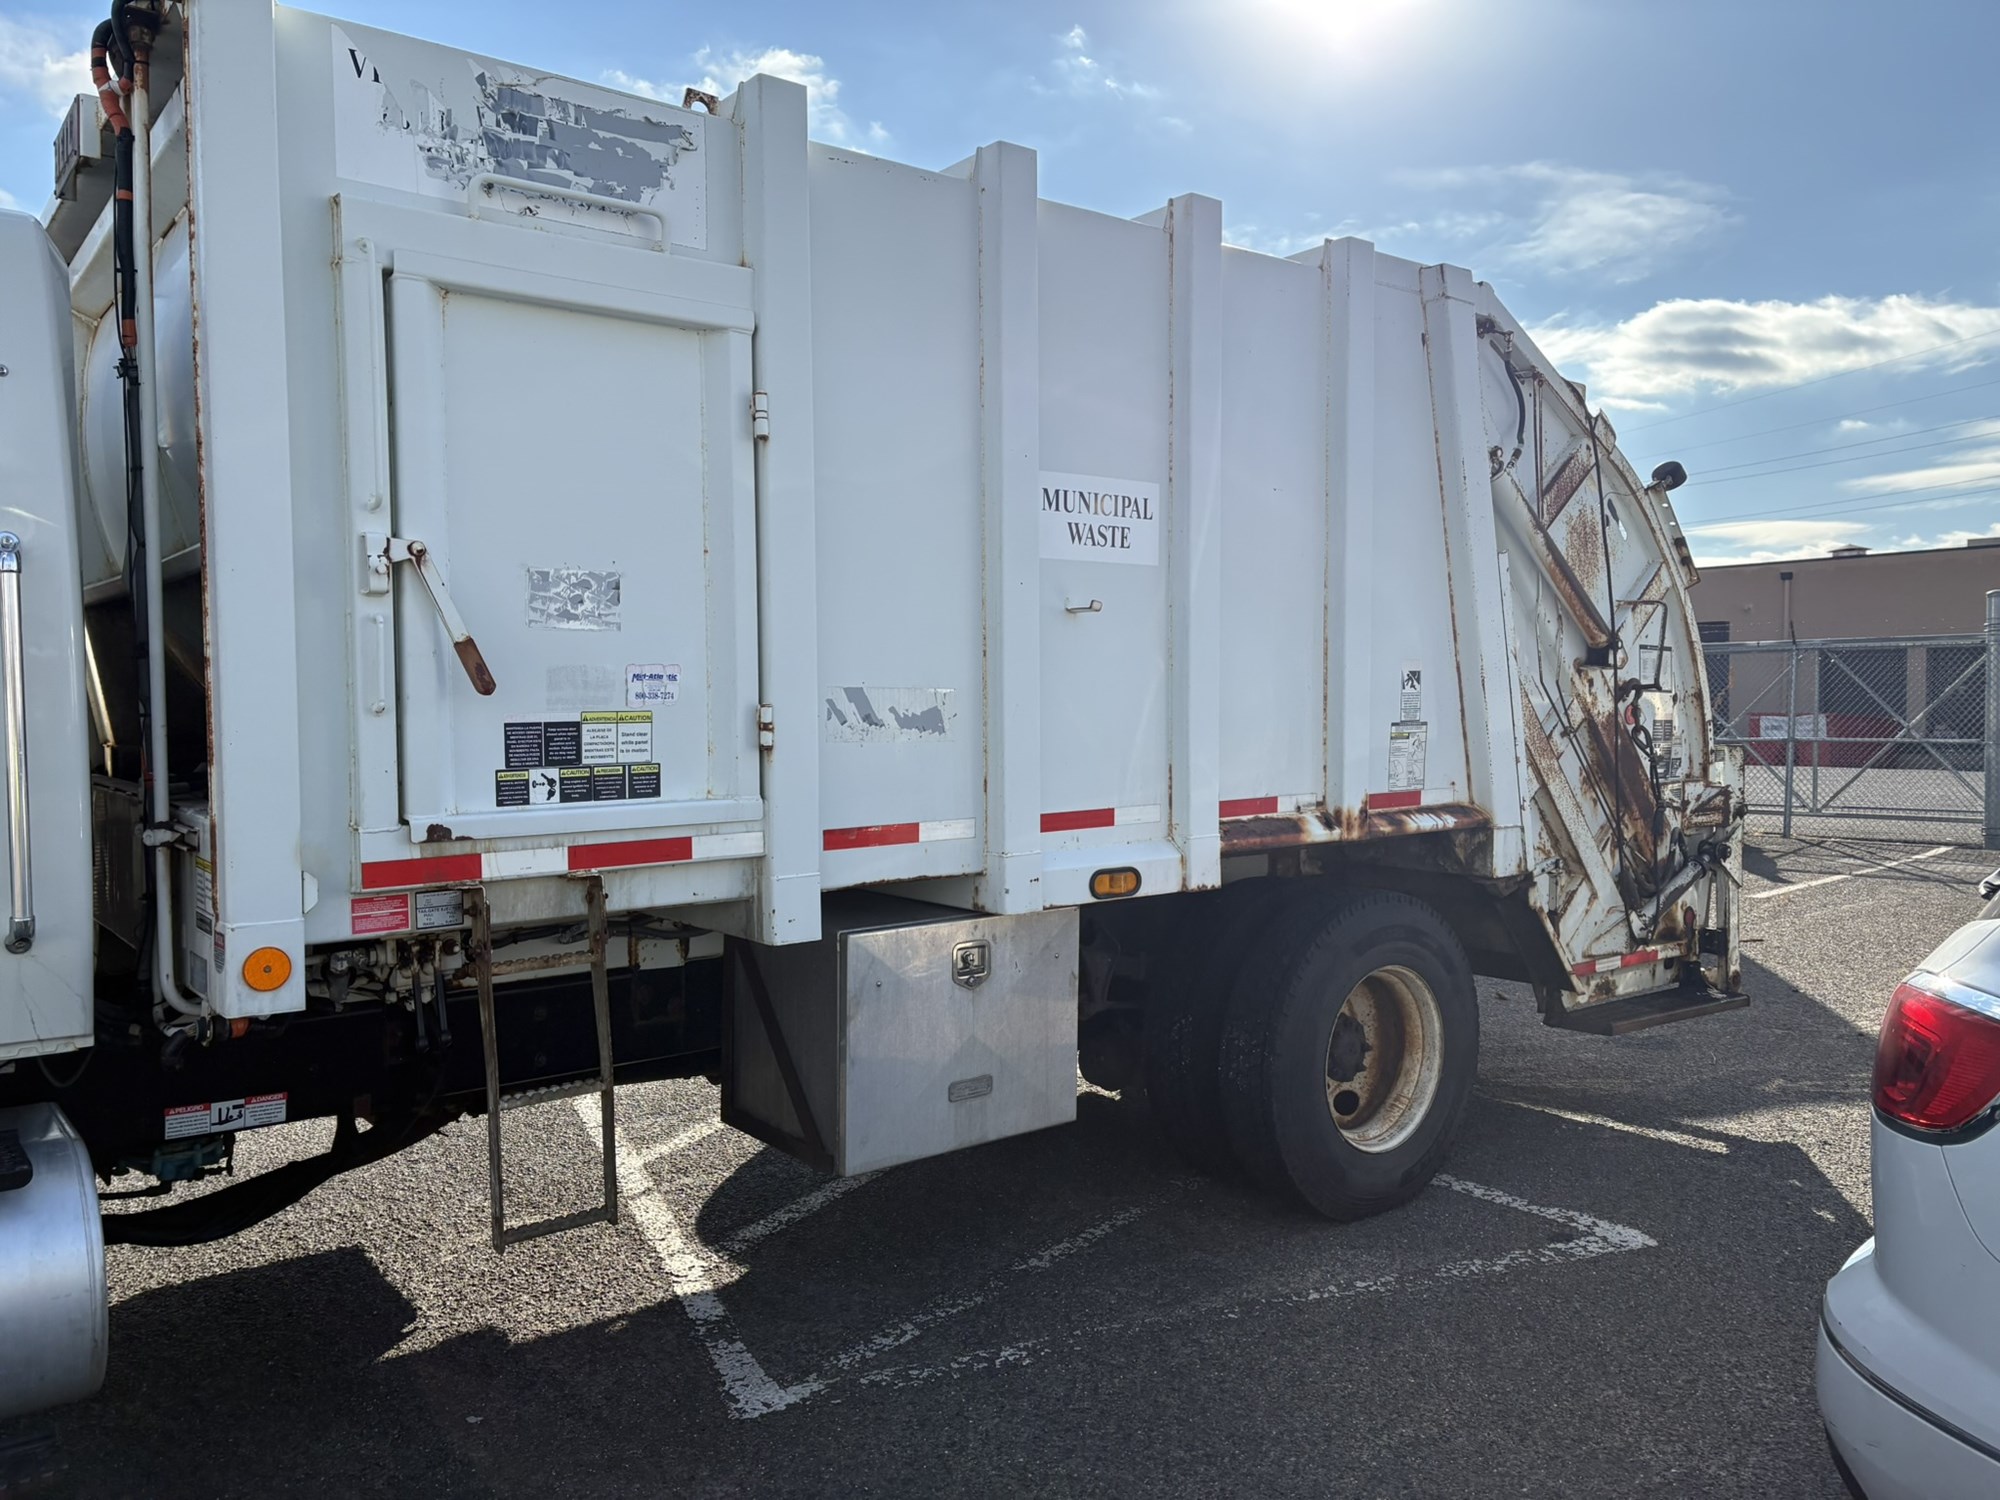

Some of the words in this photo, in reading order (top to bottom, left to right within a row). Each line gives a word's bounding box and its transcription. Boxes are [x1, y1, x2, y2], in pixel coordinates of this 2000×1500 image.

[1042, 487, 1153, 520] MUNICIPAL
[1067, 522, 1131, 549] WASTE
[566, 768, 590, 776] CAUTION
